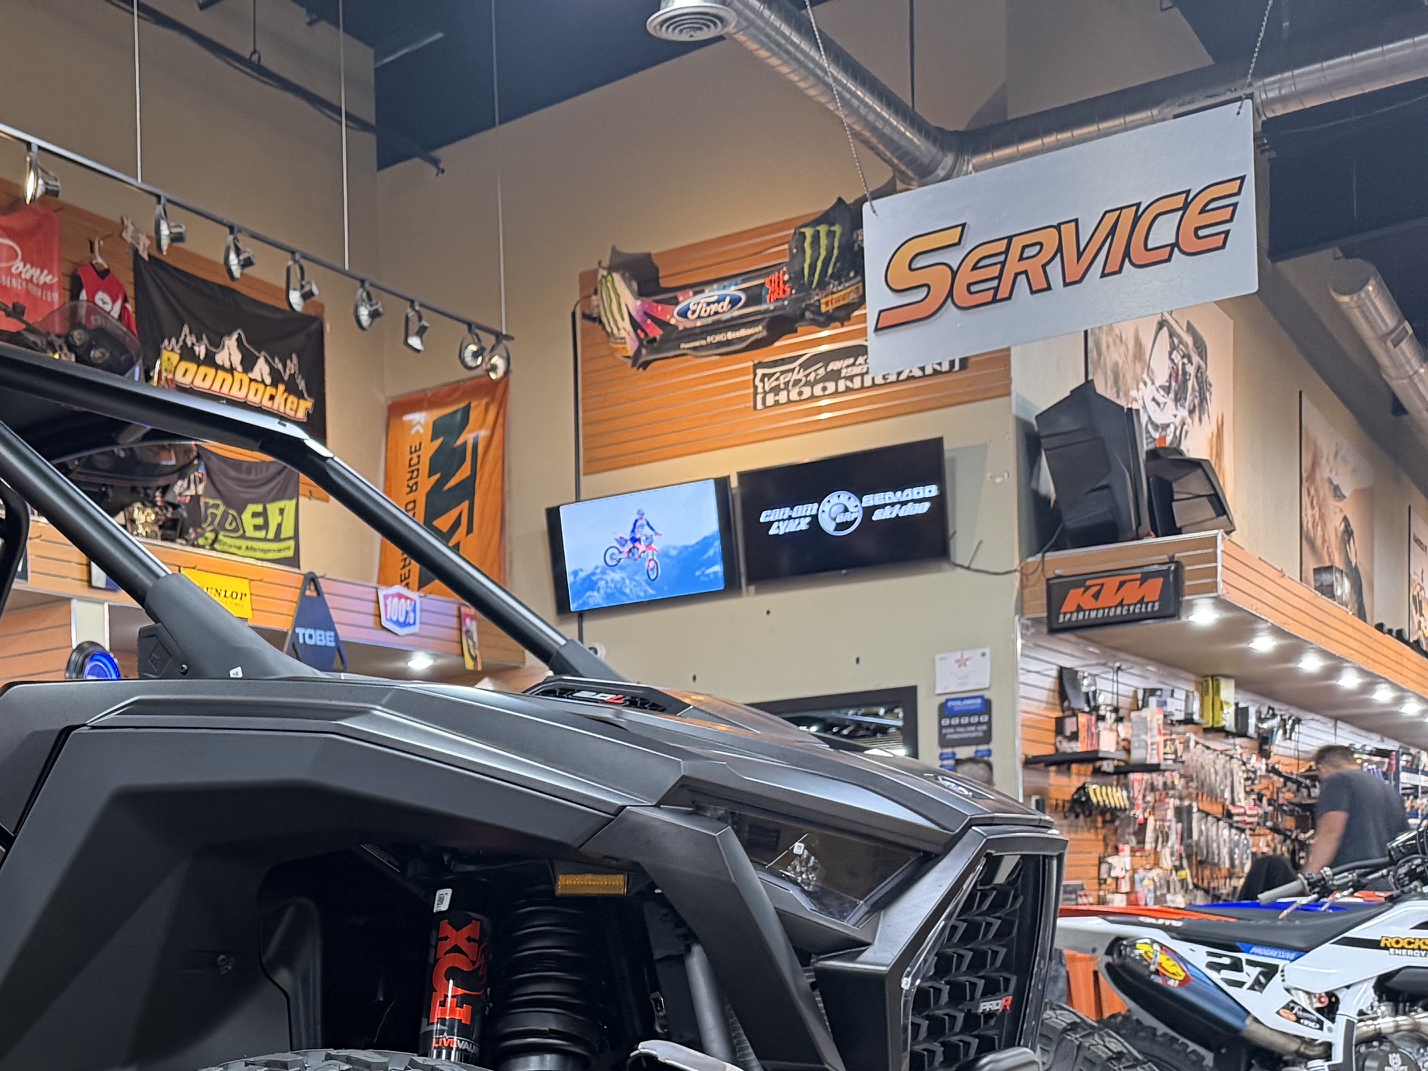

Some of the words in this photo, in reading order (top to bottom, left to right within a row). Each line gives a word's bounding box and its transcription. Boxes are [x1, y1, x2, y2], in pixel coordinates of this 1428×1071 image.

[874, 174, 1247, 333] SERVICE
[686, 296, 732, 320] Ford
[1060, 573, 1164, 613] KTM
[1058, 602, 1160, 625] SPORTMOTORCYCLES
[295, 627, 336, 647] TOBE
[1389, 947, 1428, 958] ENERGY
[1205, 951, 1280, 994] 27
